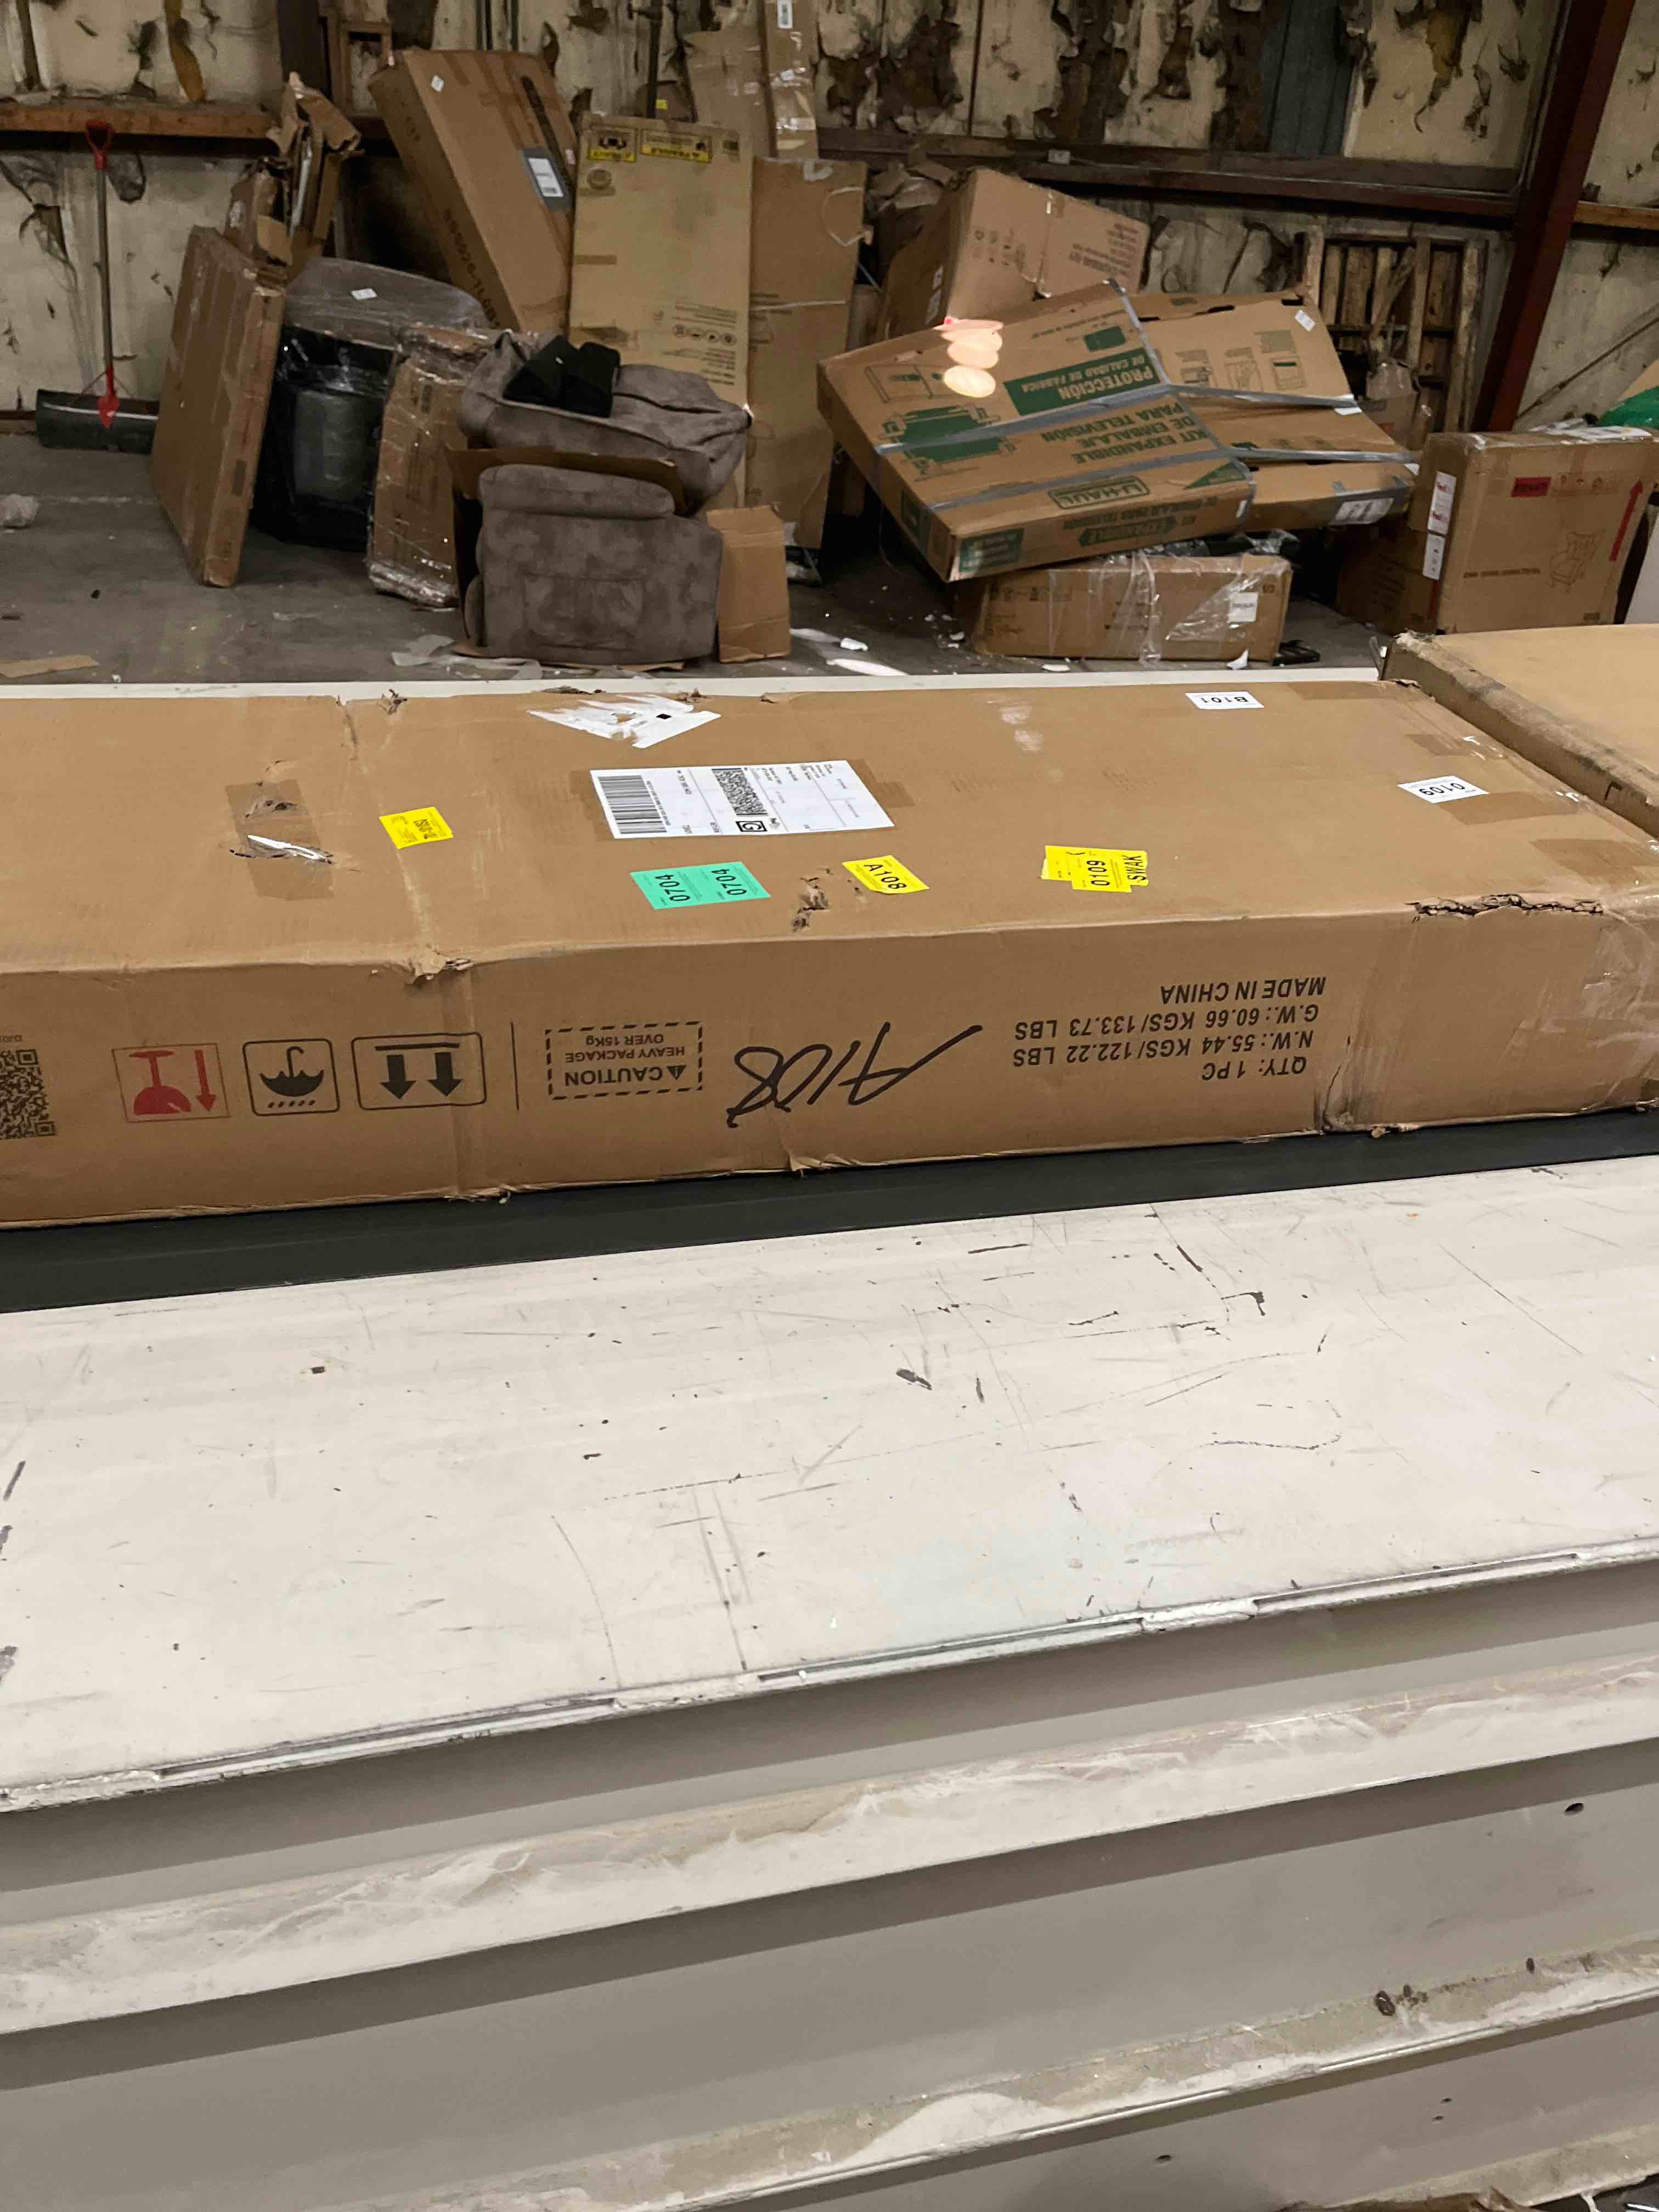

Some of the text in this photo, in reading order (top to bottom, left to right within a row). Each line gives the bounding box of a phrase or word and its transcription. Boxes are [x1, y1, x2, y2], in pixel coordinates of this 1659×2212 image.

[1058, 366, 1153, 400] PROTECCIÓN
[1136, 403, 1183, 421] PARA
[1077, 416, 1195, 448] DE EMBALAJE
[1058, 484, 1141, 505] U-HAUL
[1201, 696, 1248, 704] B101
[1419, 782, 1466, 797] 0109
[743, 822, 763, 831] G
[863, 863, 908, 891] A108
[1086, 860, 1110, 886] 0109
[1121, 854, 1147, 881] SWAK
[655, 873, 691, 902] 0704
[711, 867, 747, 896] 0704
[1160, 977, 1325, 1005] MADE IN CHINA
[1205, 1008, 1260, 1028] 60.66
[1266, 1004, 1319, 1024] G.W.:
[1015, 1020, 1058, 1040] LBS
[1069, 1015, 1135, 1036] 133.73
[586, 1034, 664, 1047] OVER 15Kg
[1202, 1034, 1255, 1054] 55.44
[1262, 1030, 1313, 1050] N.W.:
[565, 1046, 685, 1063] HEAVY PACKAGE
[1013, 1047, 1055, 1067] LBS
[1066, 1042, 1132, 1063] 122.22
[565, 1066, 663, 1086] CAUTION
[726, 1022, 983, 1128] A108
[1202, 1056, 1307, 1081] QTY: 1 PC
